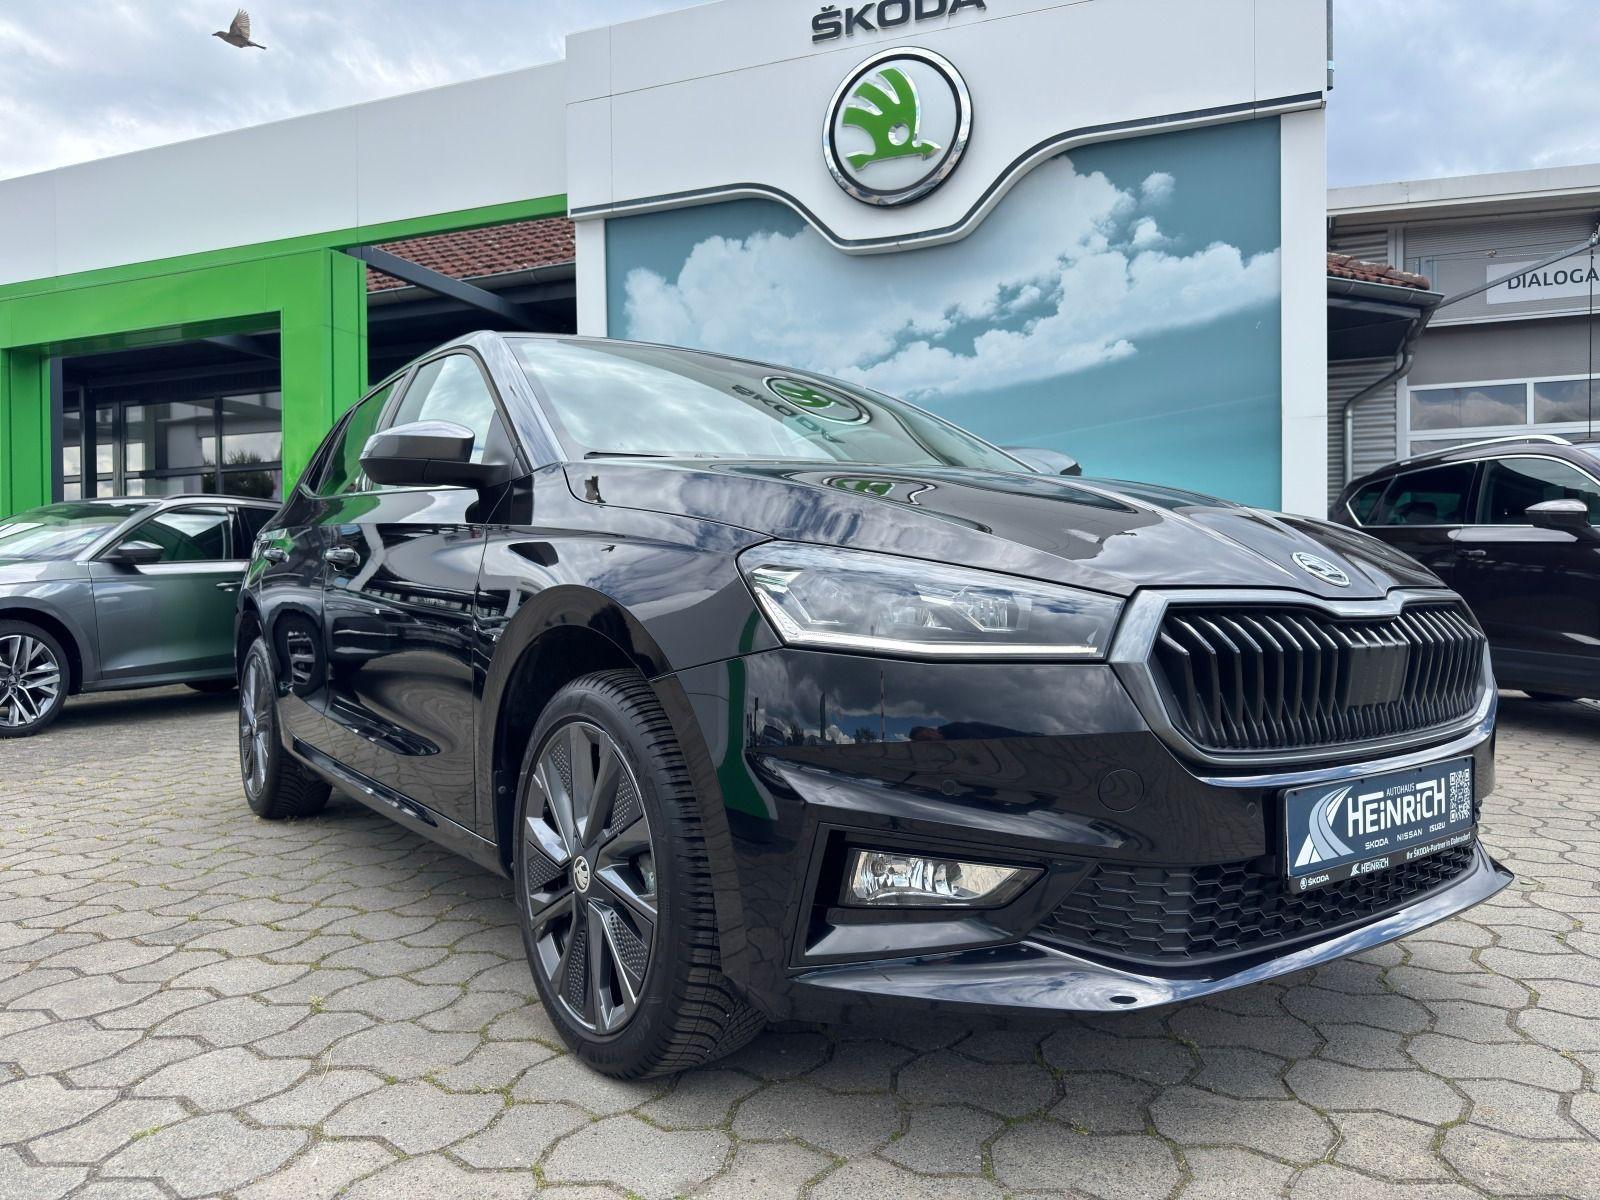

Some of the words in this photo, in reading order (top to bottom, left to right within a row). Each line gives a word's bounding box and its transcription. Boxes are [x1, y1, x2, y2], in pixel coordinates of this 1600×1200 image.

[1386, 783, 1415, 797] AUTOHAUS
[1396, 828, 1423, 842] NISSAN
[1429, 821, 1446, 833] ISUZU
[1307, 874, 1330, 886] ŠKODA
